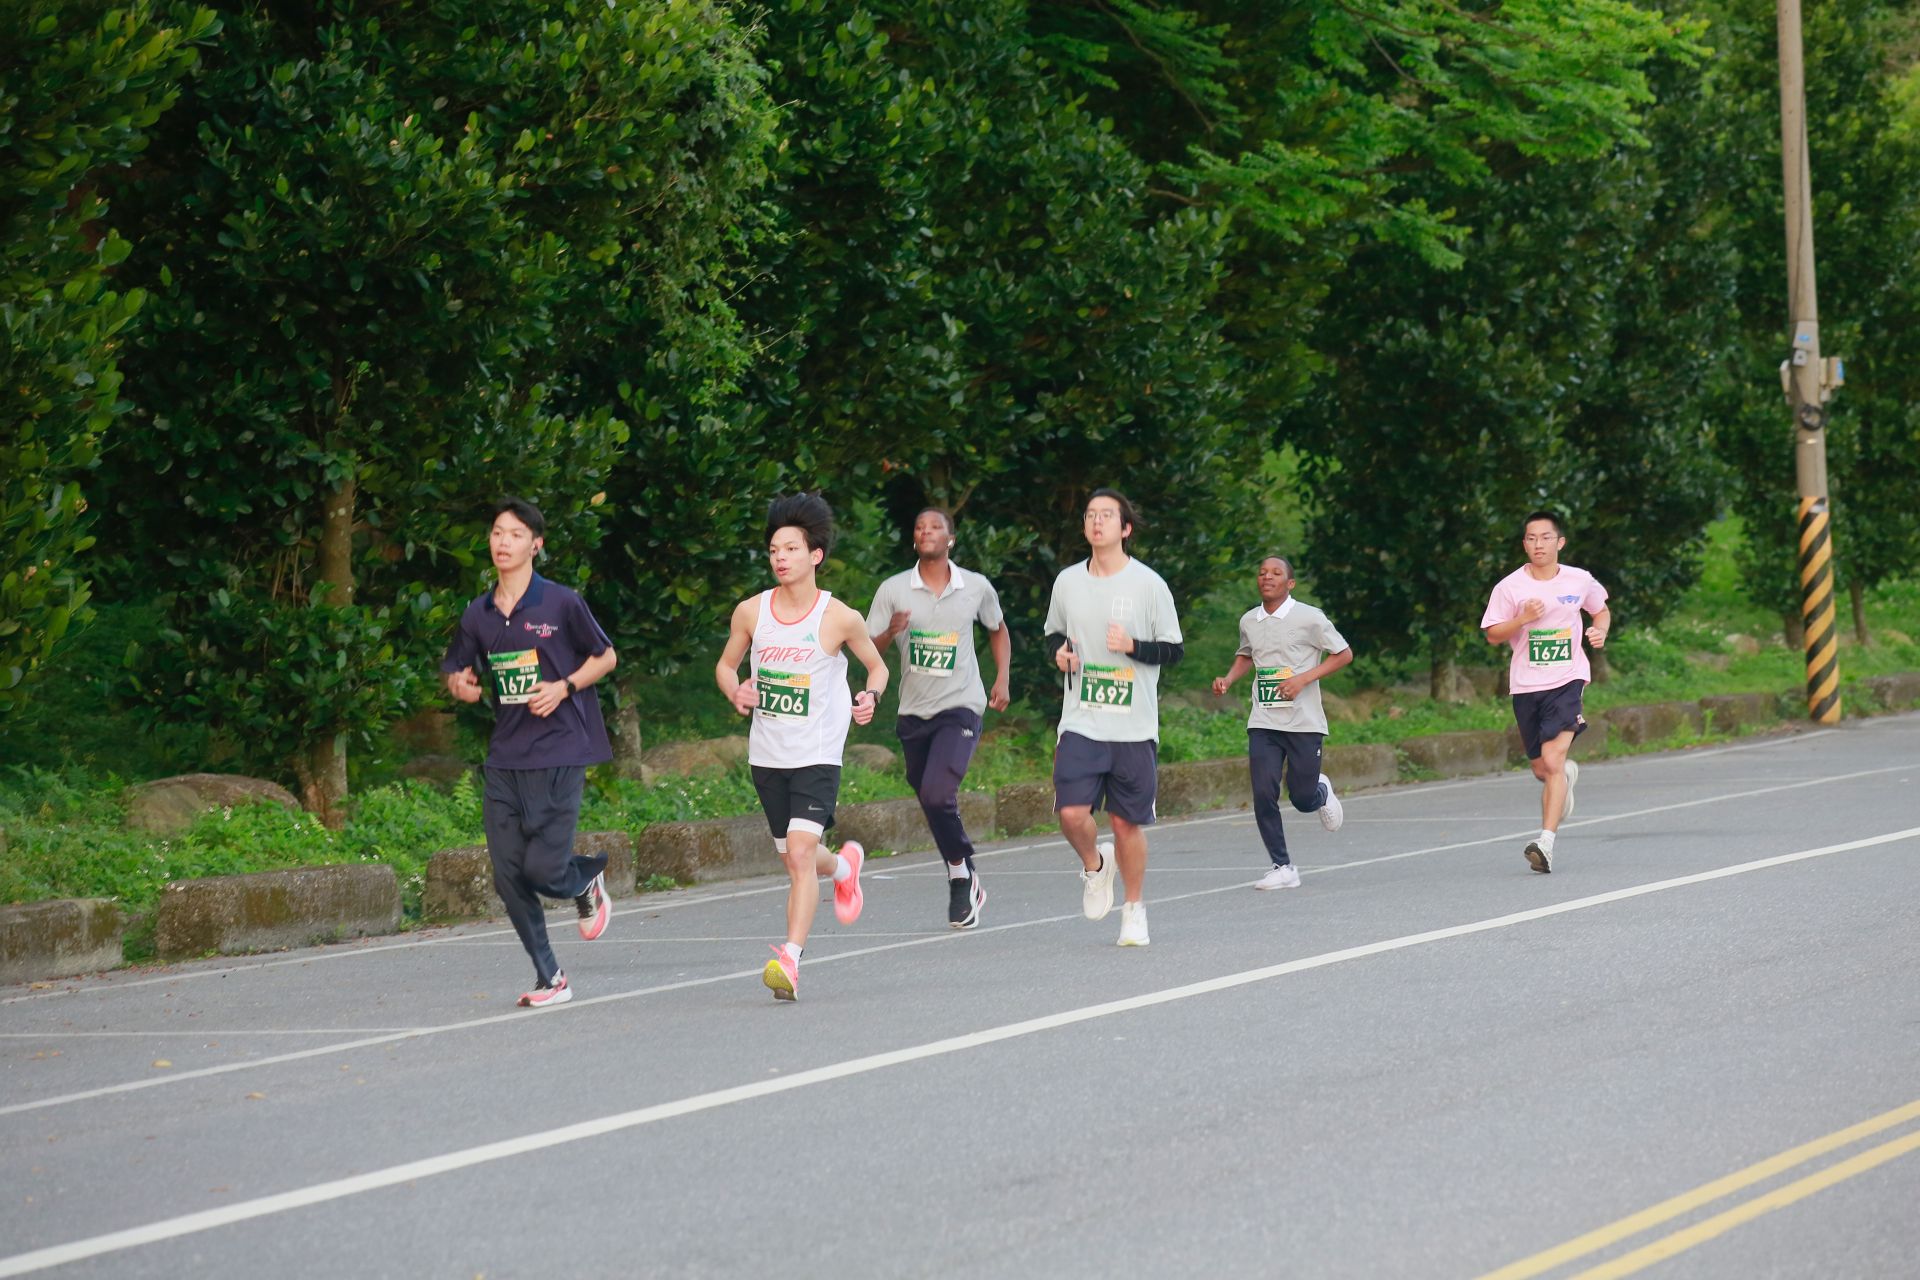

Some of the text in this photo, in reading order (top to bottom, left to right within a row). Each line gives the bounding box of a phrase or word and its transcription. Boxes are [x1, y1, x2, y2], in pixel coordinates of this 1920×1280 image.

[757, 646, 815, 663] TAIPEI
[914, 649, 953, 669] 1727
[1533, 645, 1569, 660] 1674
[499, 673, 538, 694] 1677
[1260, 686, 1282, 700] 172
[760, 691, 804, 713] 1706
[1086, 684, 1128, 705] 1697
